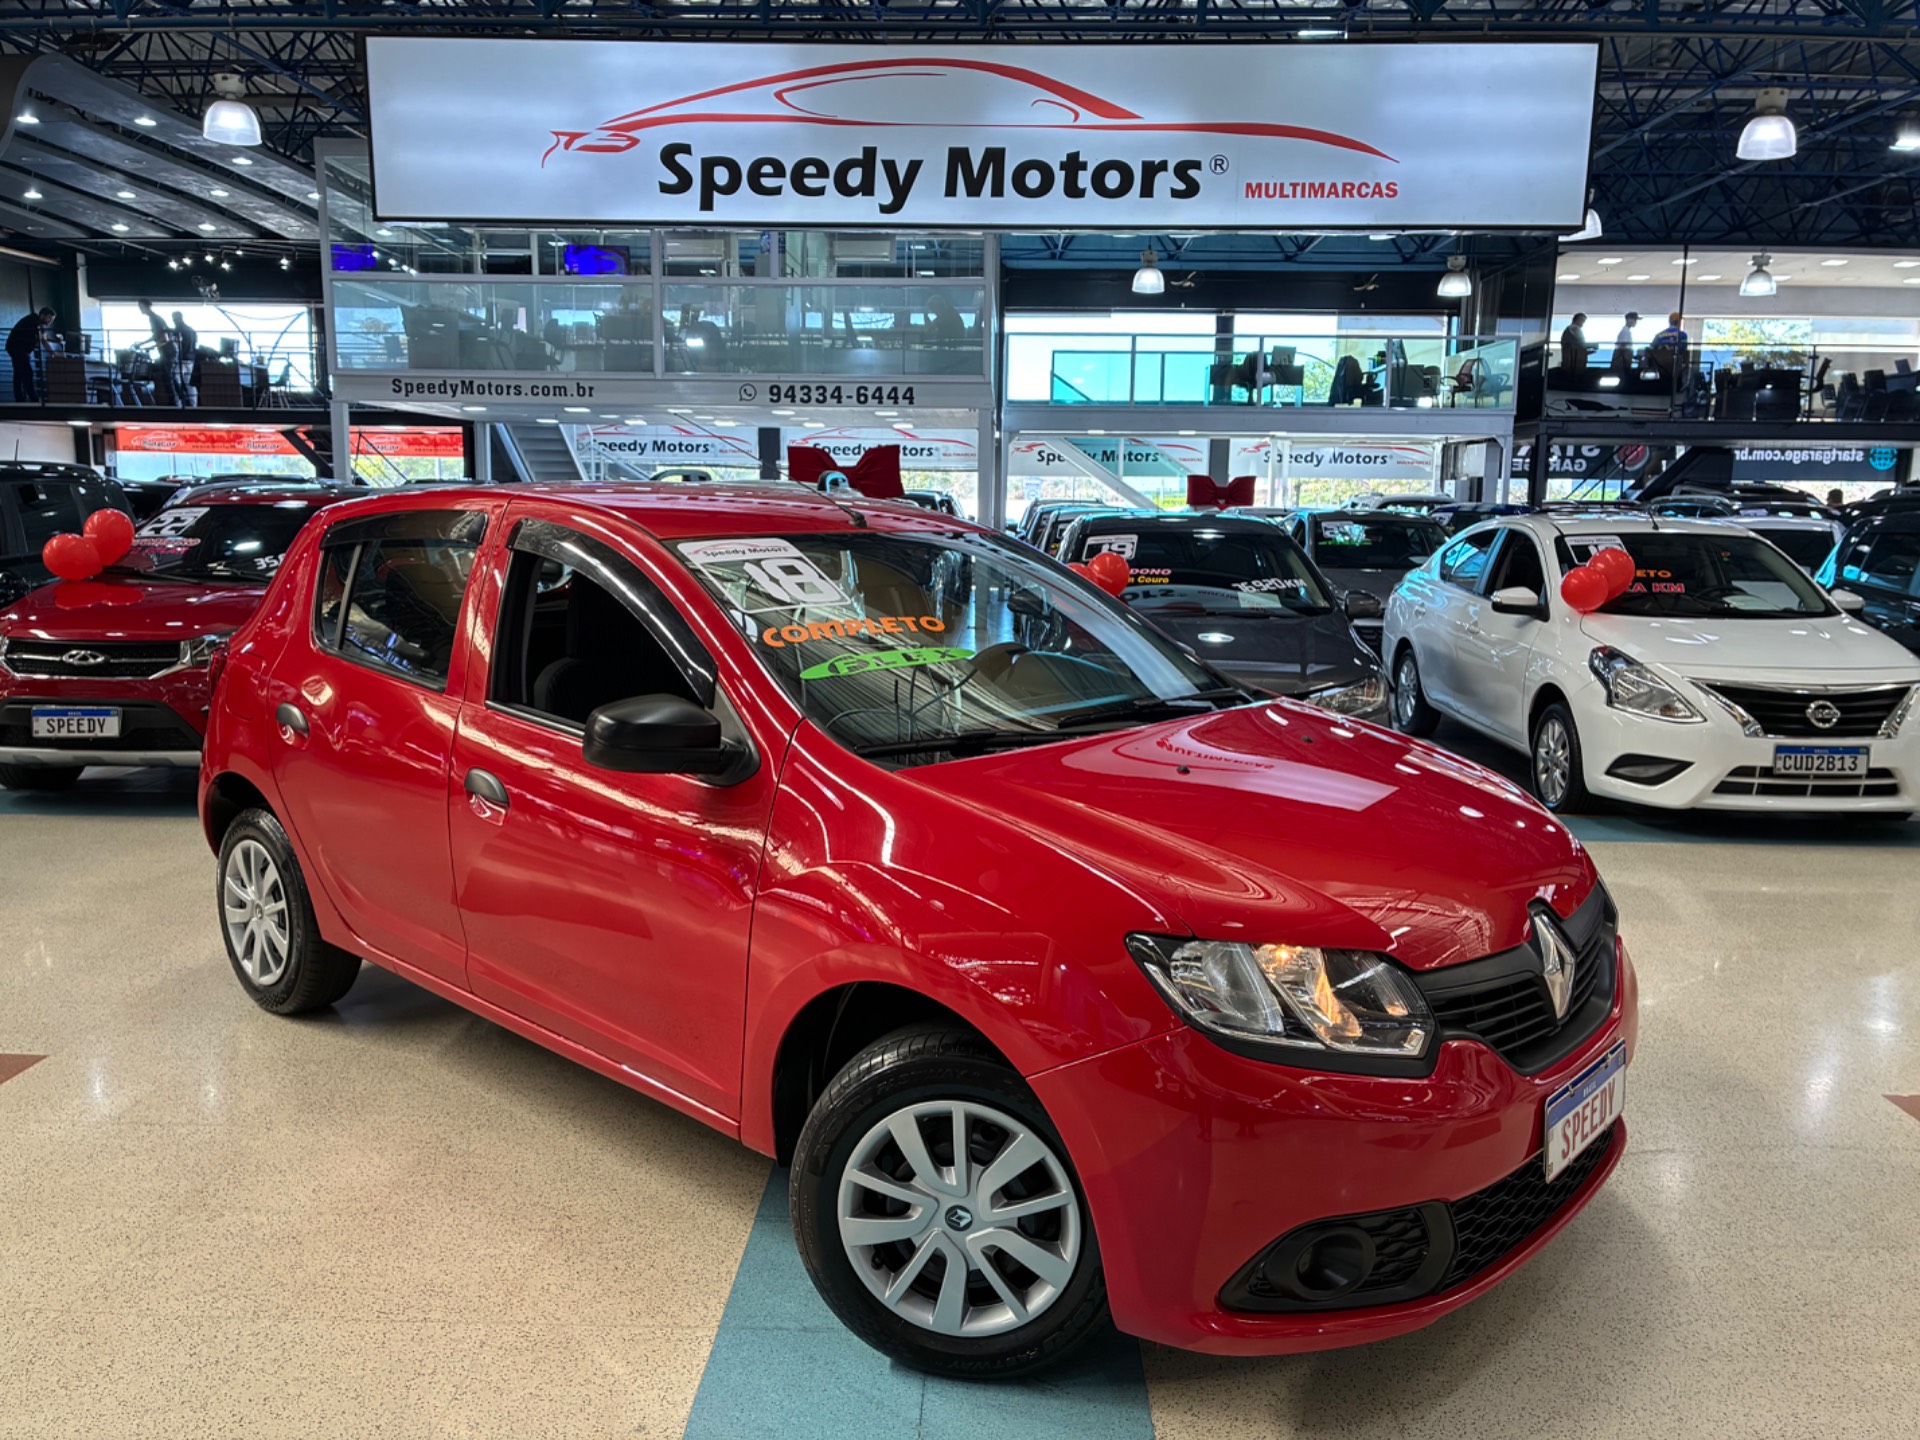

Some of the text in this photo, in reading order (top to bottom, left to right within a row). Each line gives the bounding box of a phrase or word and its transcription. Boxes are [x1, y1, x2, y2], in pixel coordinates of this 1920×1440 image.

[658, 142, 924, 214] Speedy
[1245, 181, 1398, 199] MULTIMARCAS
[392, 378, 595, 398] SpeedyMotors.com.br
[769, 384, 915, 405] 94334-6444
[652, 440, 710, 453] Motors
[140, 516, 194, 535] 22
[743, 558, 843, 603] 18
[1652, 583, 1685, 593] KM
[762, 616, 946, 648] COMPLETO
[827, 650, 957, 676] FLEX
[46, 717, 106, 734] SPEEDY
[1783, 754, 1858, 772] CUD2B13
[1561, 1077, 1616, 1161] SPEEDY
